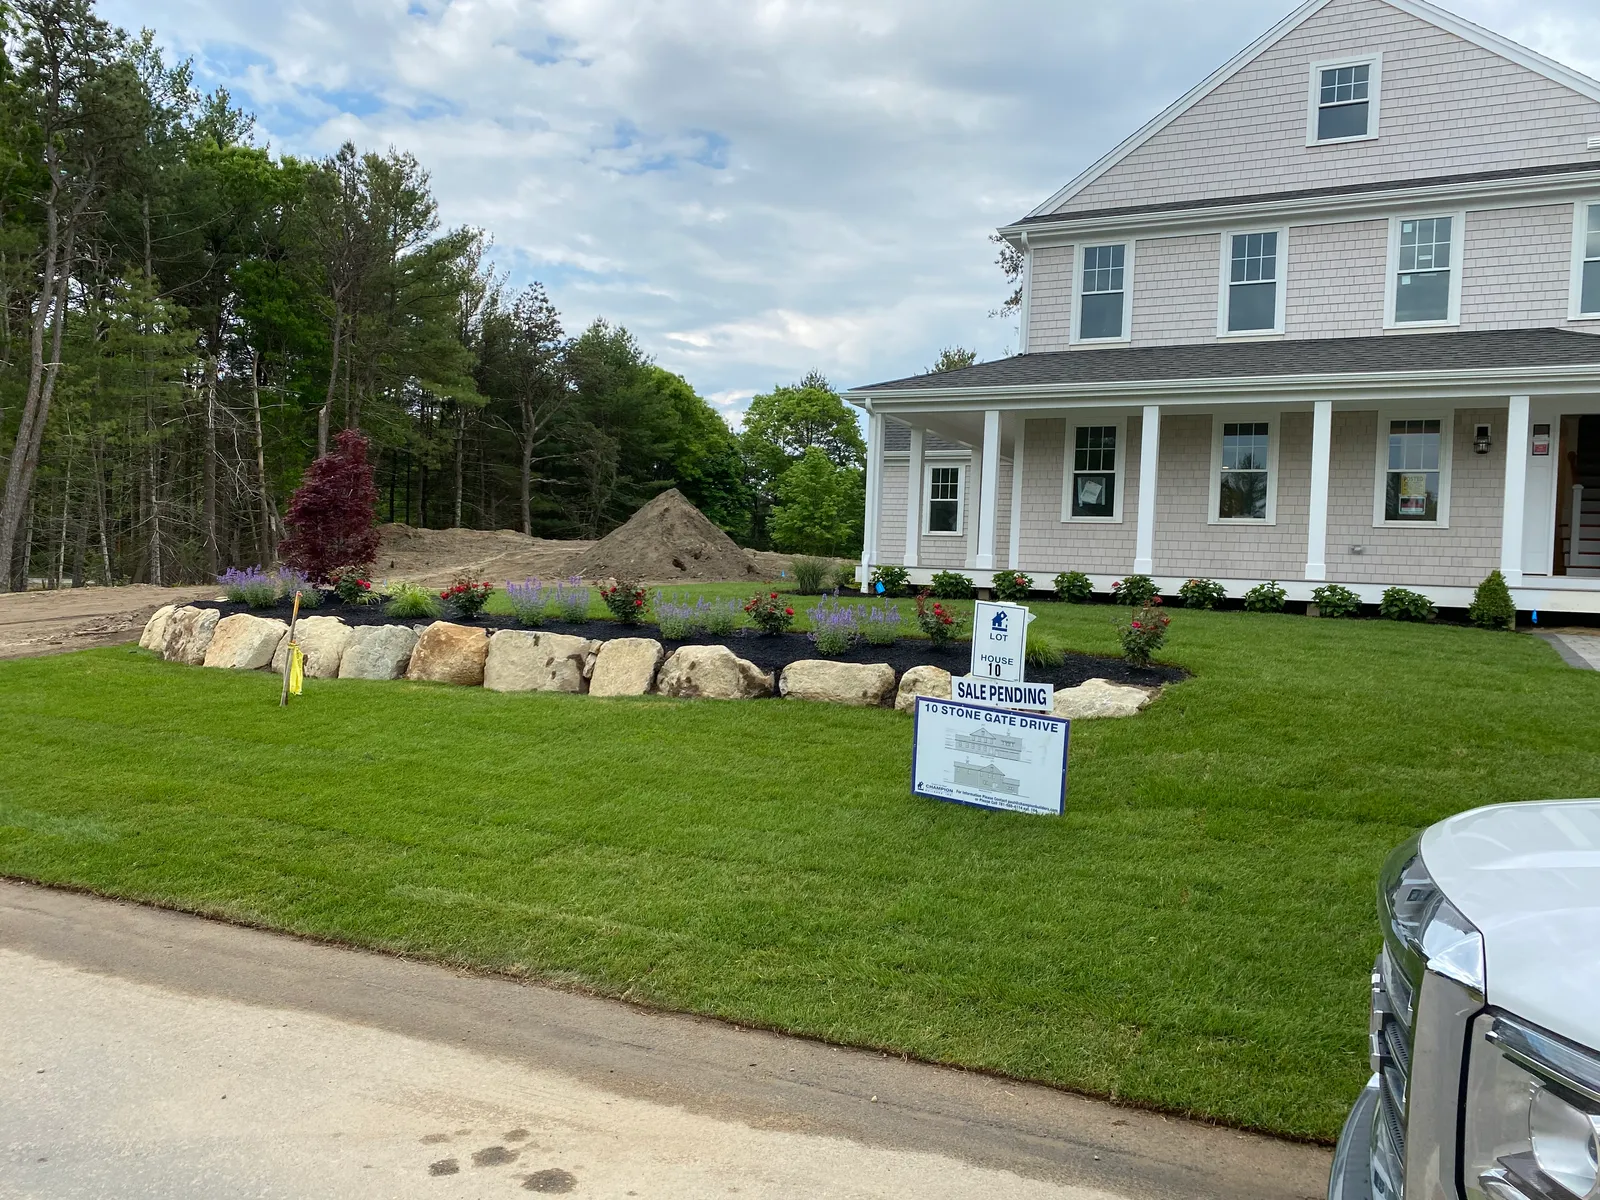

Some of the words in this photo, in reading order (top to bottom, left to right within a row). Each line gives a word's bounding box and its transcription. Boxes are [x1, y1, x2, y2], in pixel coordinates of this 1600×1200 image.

[989, 633, 1008, 641] LOT
[981, 654, 1014, 666] HOUSE
[988, 663, 1001, 677] 10
[957, 682, 986, 700] SALE
[989, 685, 1047, 706] PENDING
[925, 703, 938, 713] 10
[941, 705, 981, 720] STONE
[984, 712, 1017, 726] GATE
[1020, 718, 1059, 733] DRIVE
[925, 784, 954, 793] CHAMPION
